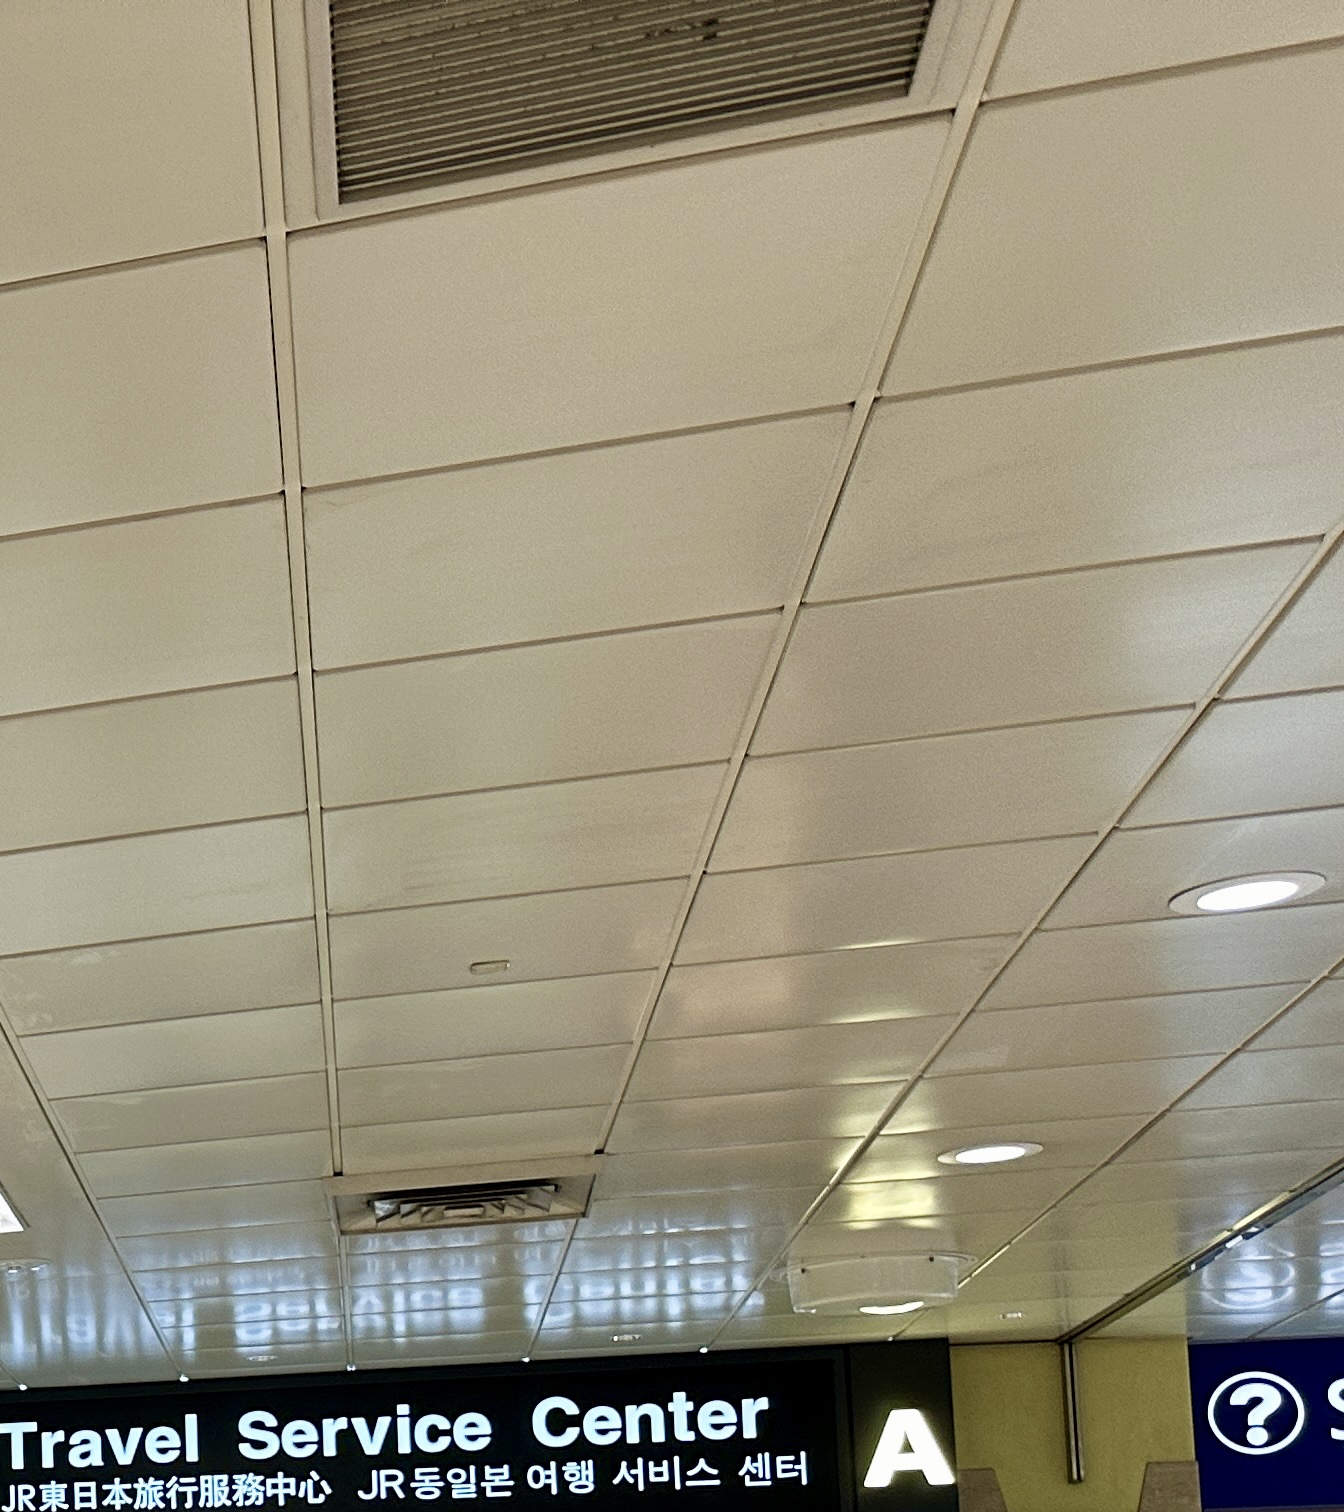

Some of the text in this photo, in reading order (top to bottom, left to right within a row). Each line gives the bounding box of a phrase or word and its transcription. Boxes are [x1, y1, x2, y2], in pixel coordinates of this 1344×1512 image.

[238, 1404, 492, 1460] Service
[532, 1392, 768, 1447] Center
[864, 1409, 954, 1487] A
[1, 1471, 332, 1512] JR東日本旅行服務中心
[357, 1451, 807, 1500] JR동일본 여행 서비스 센터
